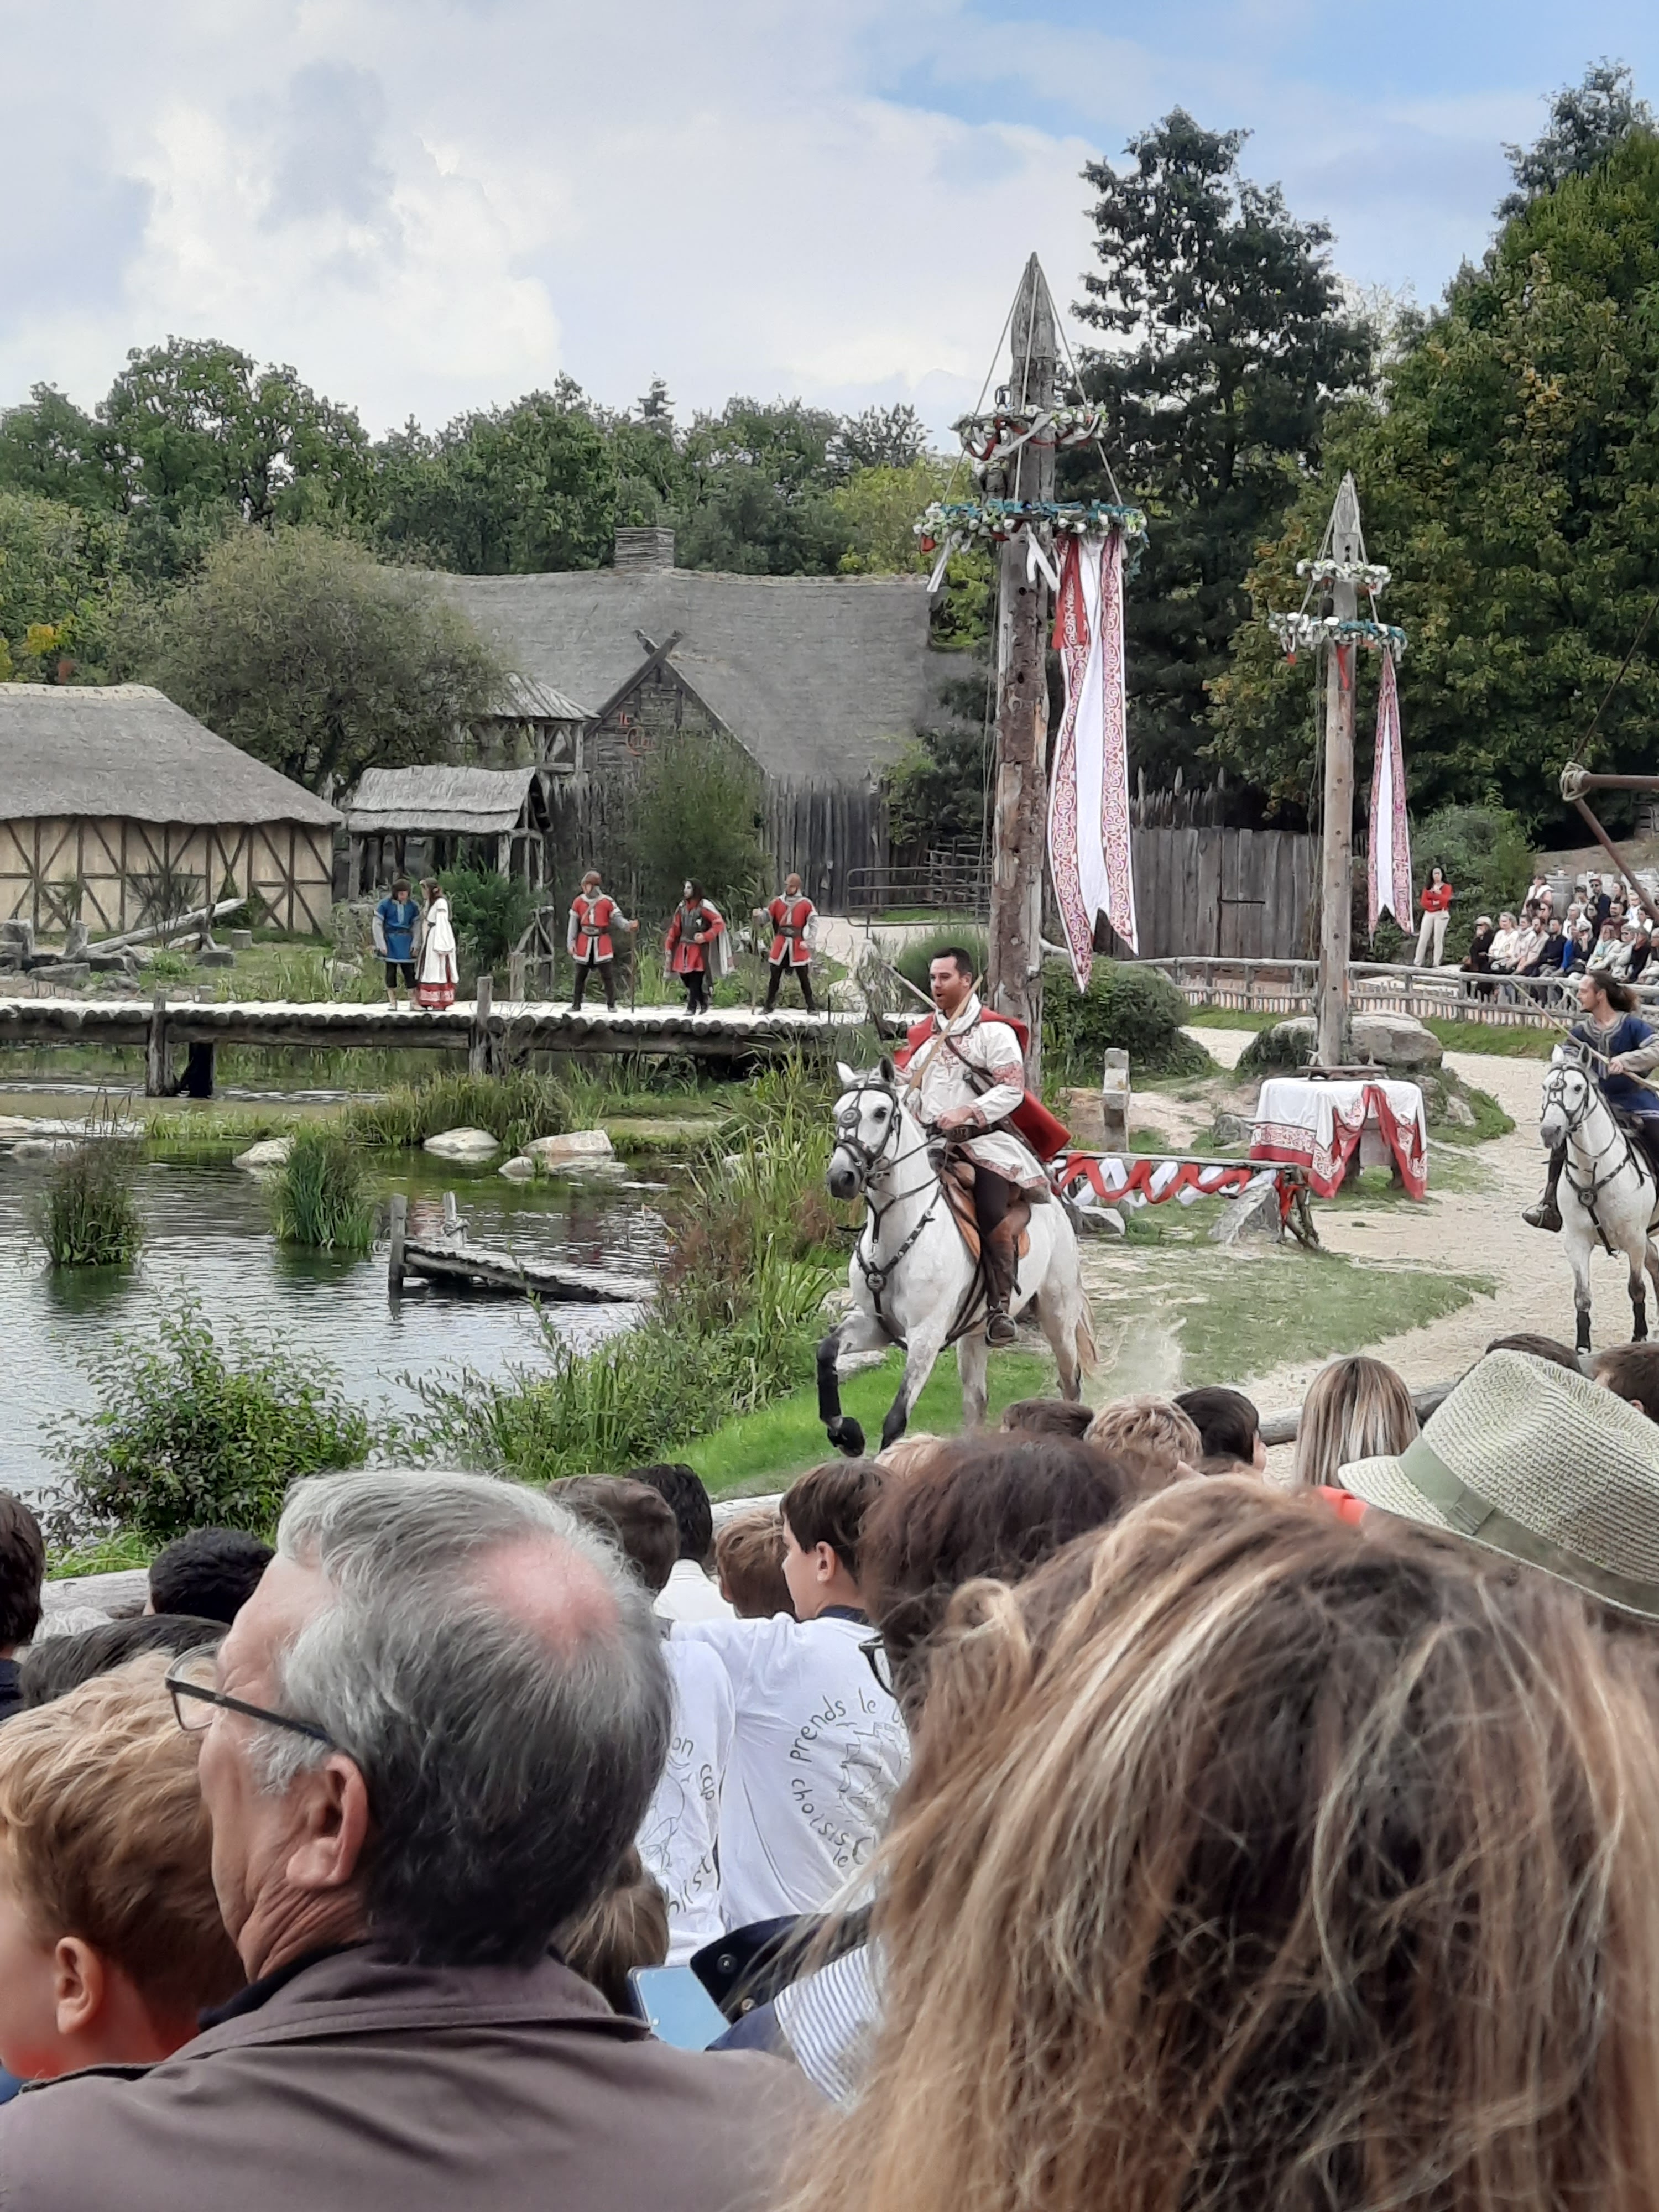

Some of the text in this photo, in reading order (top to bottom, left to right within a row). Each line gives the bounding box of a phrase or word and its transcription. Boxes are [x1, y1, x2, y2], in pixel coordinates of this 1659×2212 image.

[789, 1694, 846, 1763] prends
[858, 1687, 877, 1714] le
[671, 1736, 716, 1801] on cap
[791, 1778, 849, 1869] choisis le
